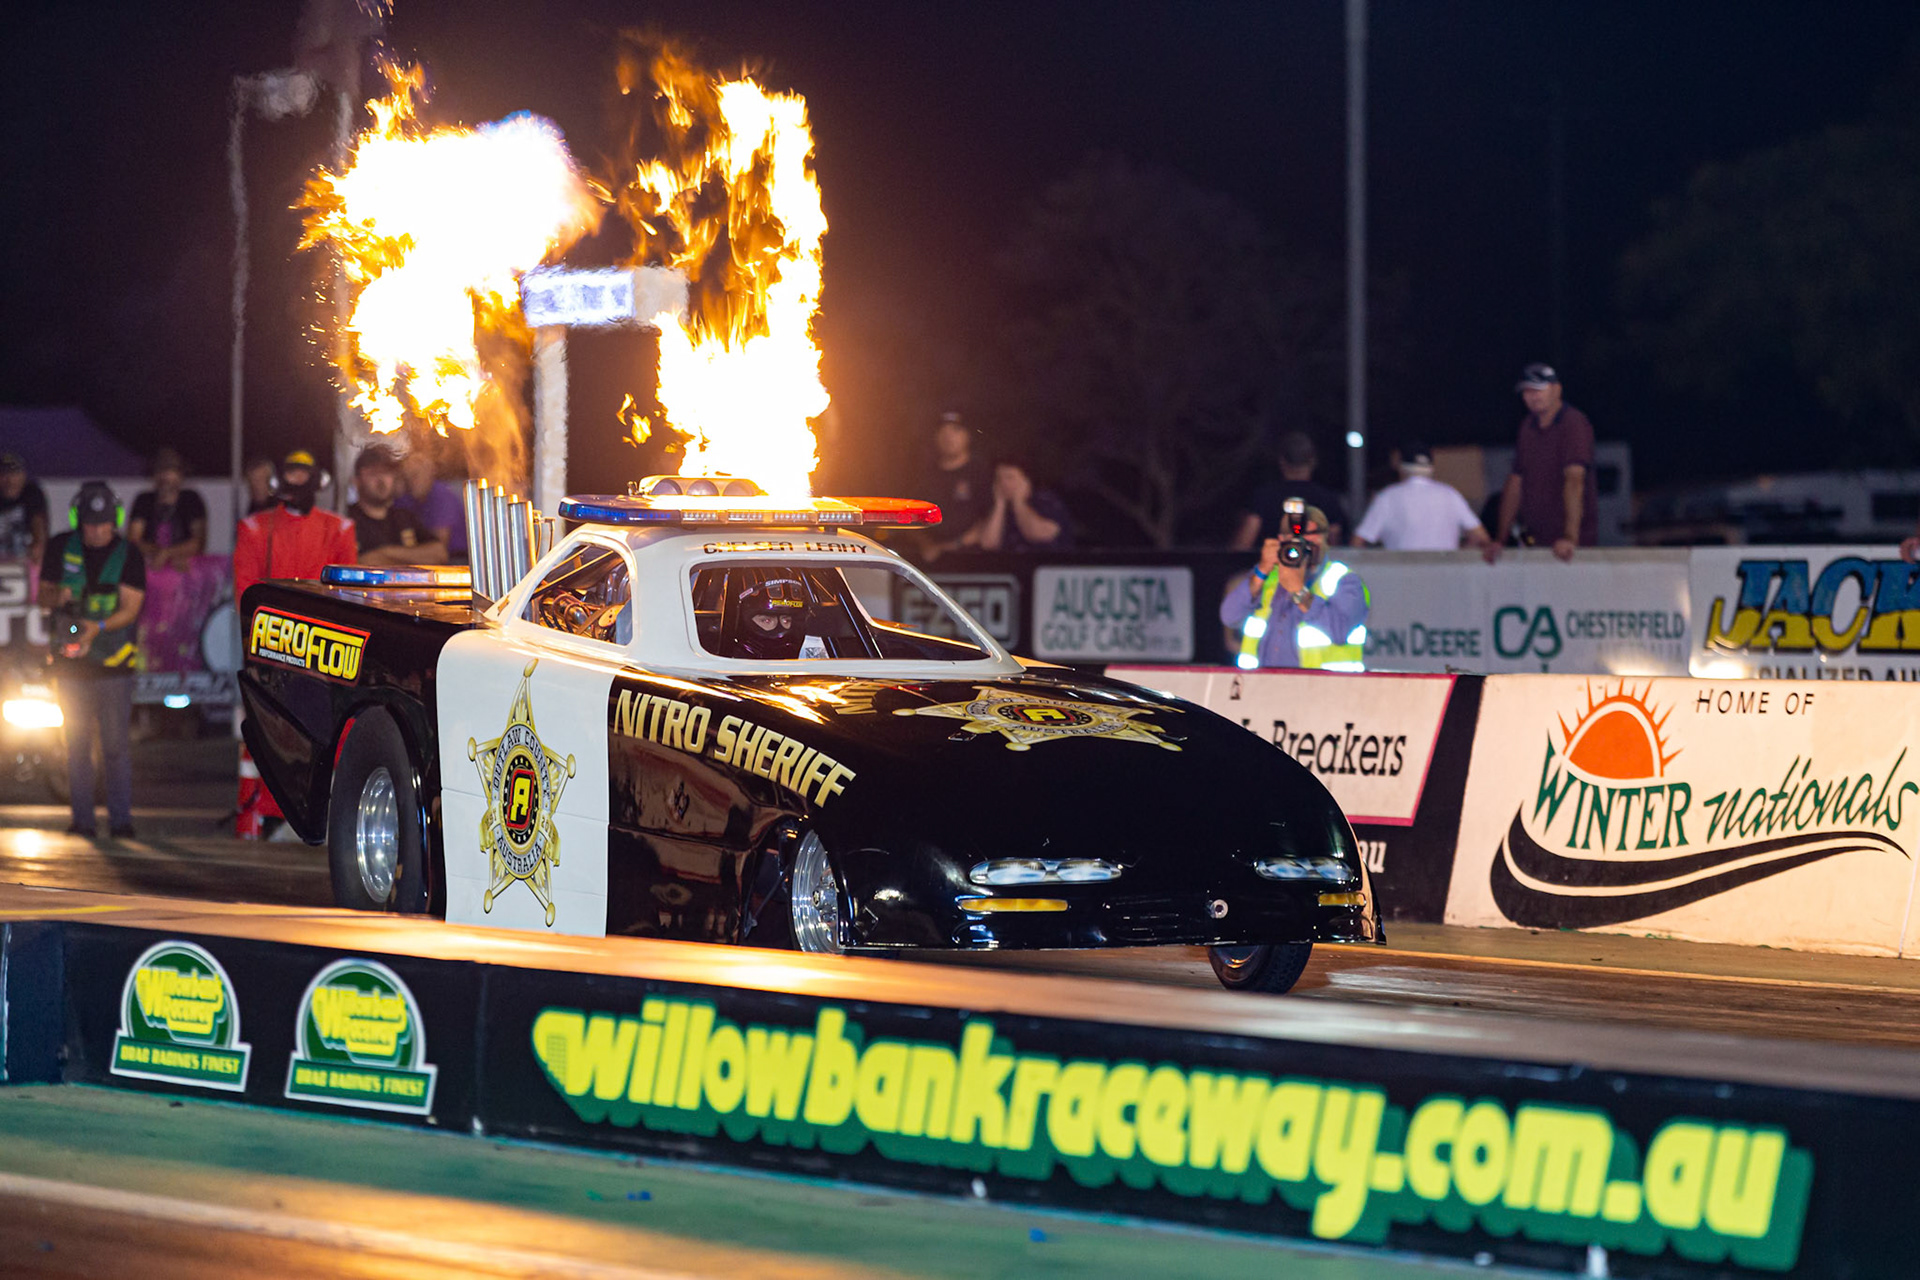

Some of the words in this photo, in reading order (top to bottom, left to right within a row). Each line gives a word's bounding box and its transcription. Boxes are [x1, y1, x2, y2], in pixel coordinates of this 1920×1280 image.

[805, 541, 867, 554] LEAHY
[1053, 577, 1174, 620] AUGUSTA
[1366, 624, 1407, 658] OHN
[1410, 621, 1481, 657] DEERE
[1565, 610, 1685, 641] CHESTERFIELD
[250, 612, 365, 680] AEROFLOW
[1696, 689, 1769, 714] HOME
[1784, 692, 1815, 715] OF
[613, 688, 712, 754] NITRO
[714, 714, 857, 808] SHERIFF
[1532, 728, 1692, 855] WINTER
[1703, 746, 1919, 844] nationals
[497, 836, 542, 873] AUSTRALIA
[533, 998, 1787, 1239] willowbankraceway.com.au
